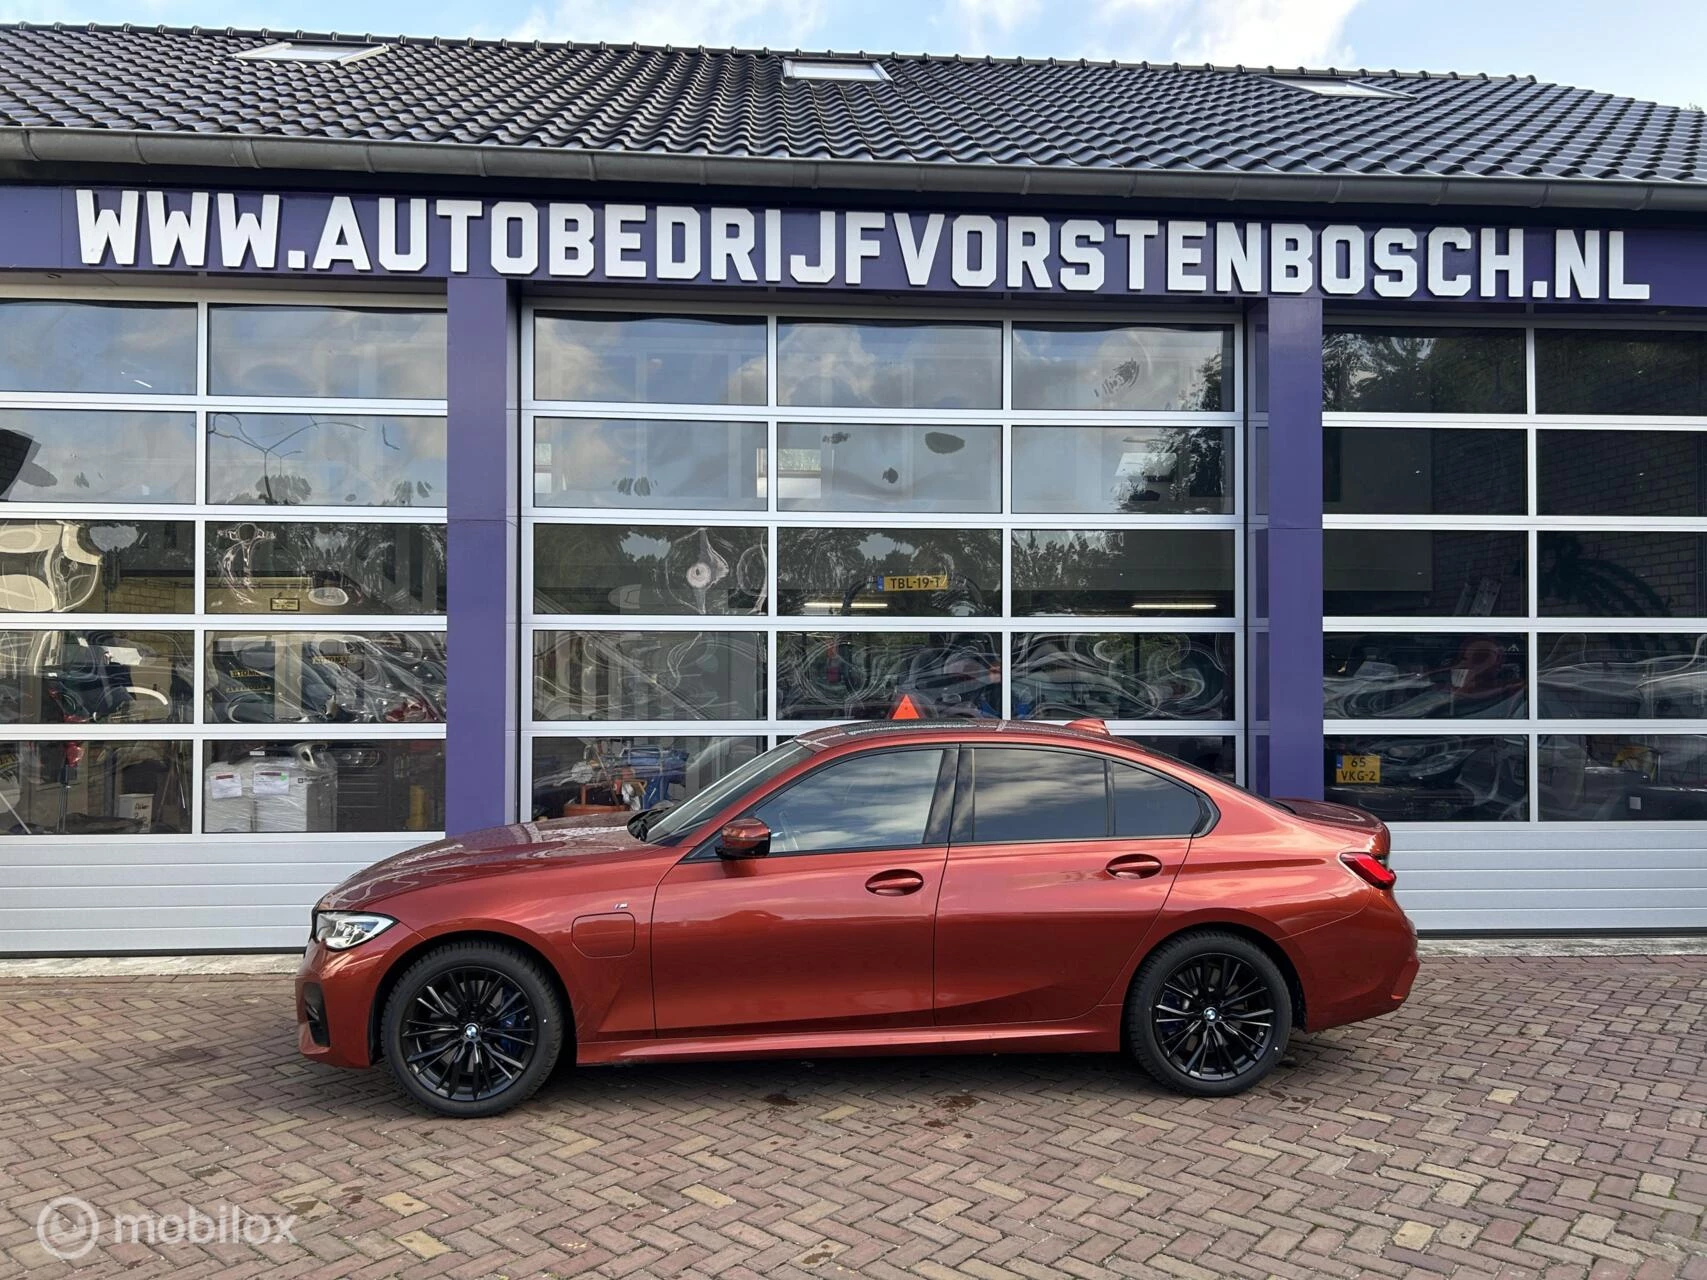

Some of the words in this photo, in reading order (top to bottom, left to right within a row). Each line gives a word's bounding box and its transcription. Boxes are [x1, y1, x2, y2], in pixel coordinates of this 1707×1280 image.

[76, 189, 1650, 300] WWW.AUTOBEDRIJFVORSTENBOSCH.NL
[1351, 757, 1366, 767] 65
[1341, 770, 1376, 781] VKG-2
